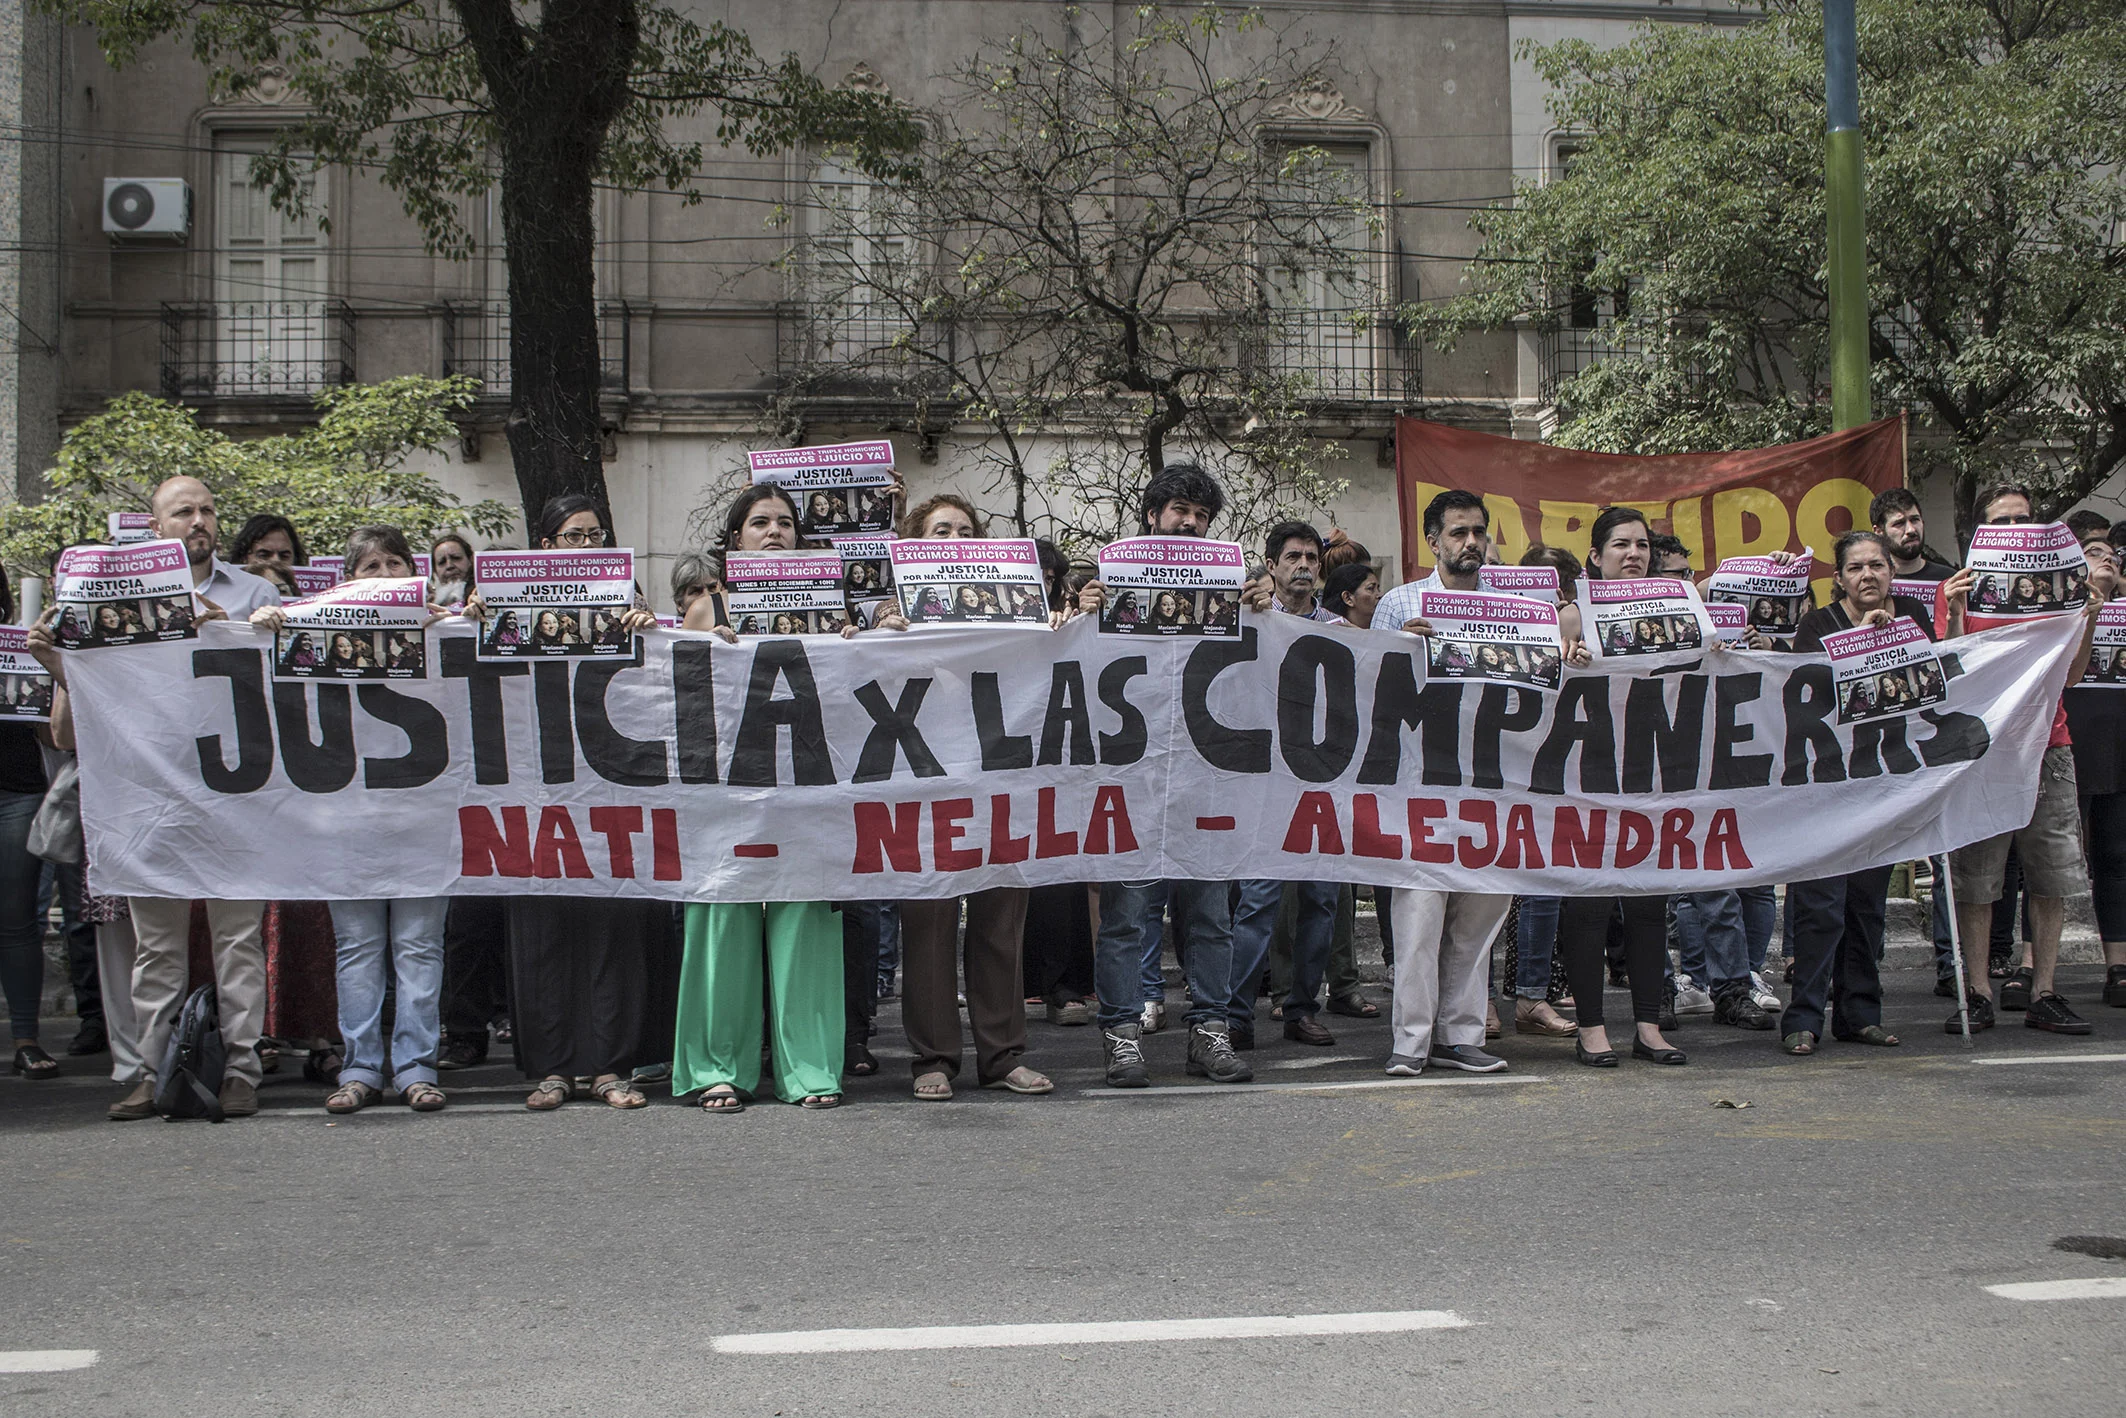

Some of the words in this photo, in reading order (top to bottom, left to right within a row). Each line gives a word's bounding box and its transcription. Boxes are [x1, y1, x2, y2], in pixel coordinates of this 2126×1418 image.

[756, 455, 815, 466] EXIGIMOS
[867, 451, 886, 460] YA!
[794, 468, 853, 479] JUSTICIA
[780, 479, 802, 487] NATI,
[804, 478, 830, 486] NELLA
[840, 475, 886, 483] ALEJANDRA
[837, 542, 887, 550] JUSTICIA
[1975, 538, 2024, 547] EXIGIMOS
[103, 553, 129, 563] TRIPLE
[132, 548, 177, 560] HOMICIDIO
[896, 551, 959, 561] EXIGIMOS
[1010, 552, 1031, 561] YA!
[1104, 550, 1164, 560] EXIGIMOS
[1216, 553, 1236, 563] YA!
[2001, 552, 2059, 563] JUSTICIA
[158, 555, 180, 568] YA!
[550, 558, 578, 566] TRIPLE
[1972, 560, 1987, 568] POR
[1989, 561, 2008, 570] NATI,
[481, 568, 547, 579] EXIGIMOS
[604, 566, 625, 576] YA!
[727, 568, 779, 578] EXIGIMOS
[825, 567, 841, 575] YA!
[937, 565, 999, 575] JUSTICIA
[1142, 567, 1203, 578] JUSTICIA
[924, 574, 947, 582] NATI,
[1127, 576, 1150, 584] NATI,
[1152, 577, 1178, 585] NELLA
[1188, 578, 1237, 586] ALEJANDRA
[1536, 577, 1553, 586] YA!
[1745, 577, 1797, 588] JUSTICIA
[79, 578, 144, 591] JUSTICIA
[522, 584, 588, 596] JUSTICIA
[72, 591, 86, 599] NATI,
[88, 590, 117, 598] NELLA
[130, 583, 184, 595] ALEJANDRA
[1592, 589, 1631, 598] EXIGIMOS
[396, 592, 417, 602] YA!
[507, 596, 530, 604] NATI,
[572, 594, 625, 602] ALEJANDRA
[760, 593, 813, 603] JUSTICIA
[1426, 604, 1483, 616] EXIGIMOS
[1533, 611, 1552, 620] YA!
[1620, 601, 1665, 612] JUSTICIA
[316, 607, 380, 619] JUSTICIA
[301, 618, 323, 626] NATI,
[325, 618, 353, 626] NELLA
[364, 618, 419, 626] ALEJANDRA
[1728, 616, 1742, 624] YA!
[1460, 622, 1519, 635] JUSTICIA
[1446, 631, 1468, 640] NATI,
[1470, 632, 1496, 640] NELLA
[1505, 634, 1553, 643] ALEJANDRA
[1831, 639, 1876, 656] EXIGIMOS
[1864, 647, 1909, 666] JUSTICIA
[193, 637, 837, 793] JUSTICIA
[971, 655, 1148, 771] LAS
[458, 805, 682, 881] NATI
[852, 786, 1140, 874] NELLA
[1281, 791, 1753, 870] ALEJANDRA
